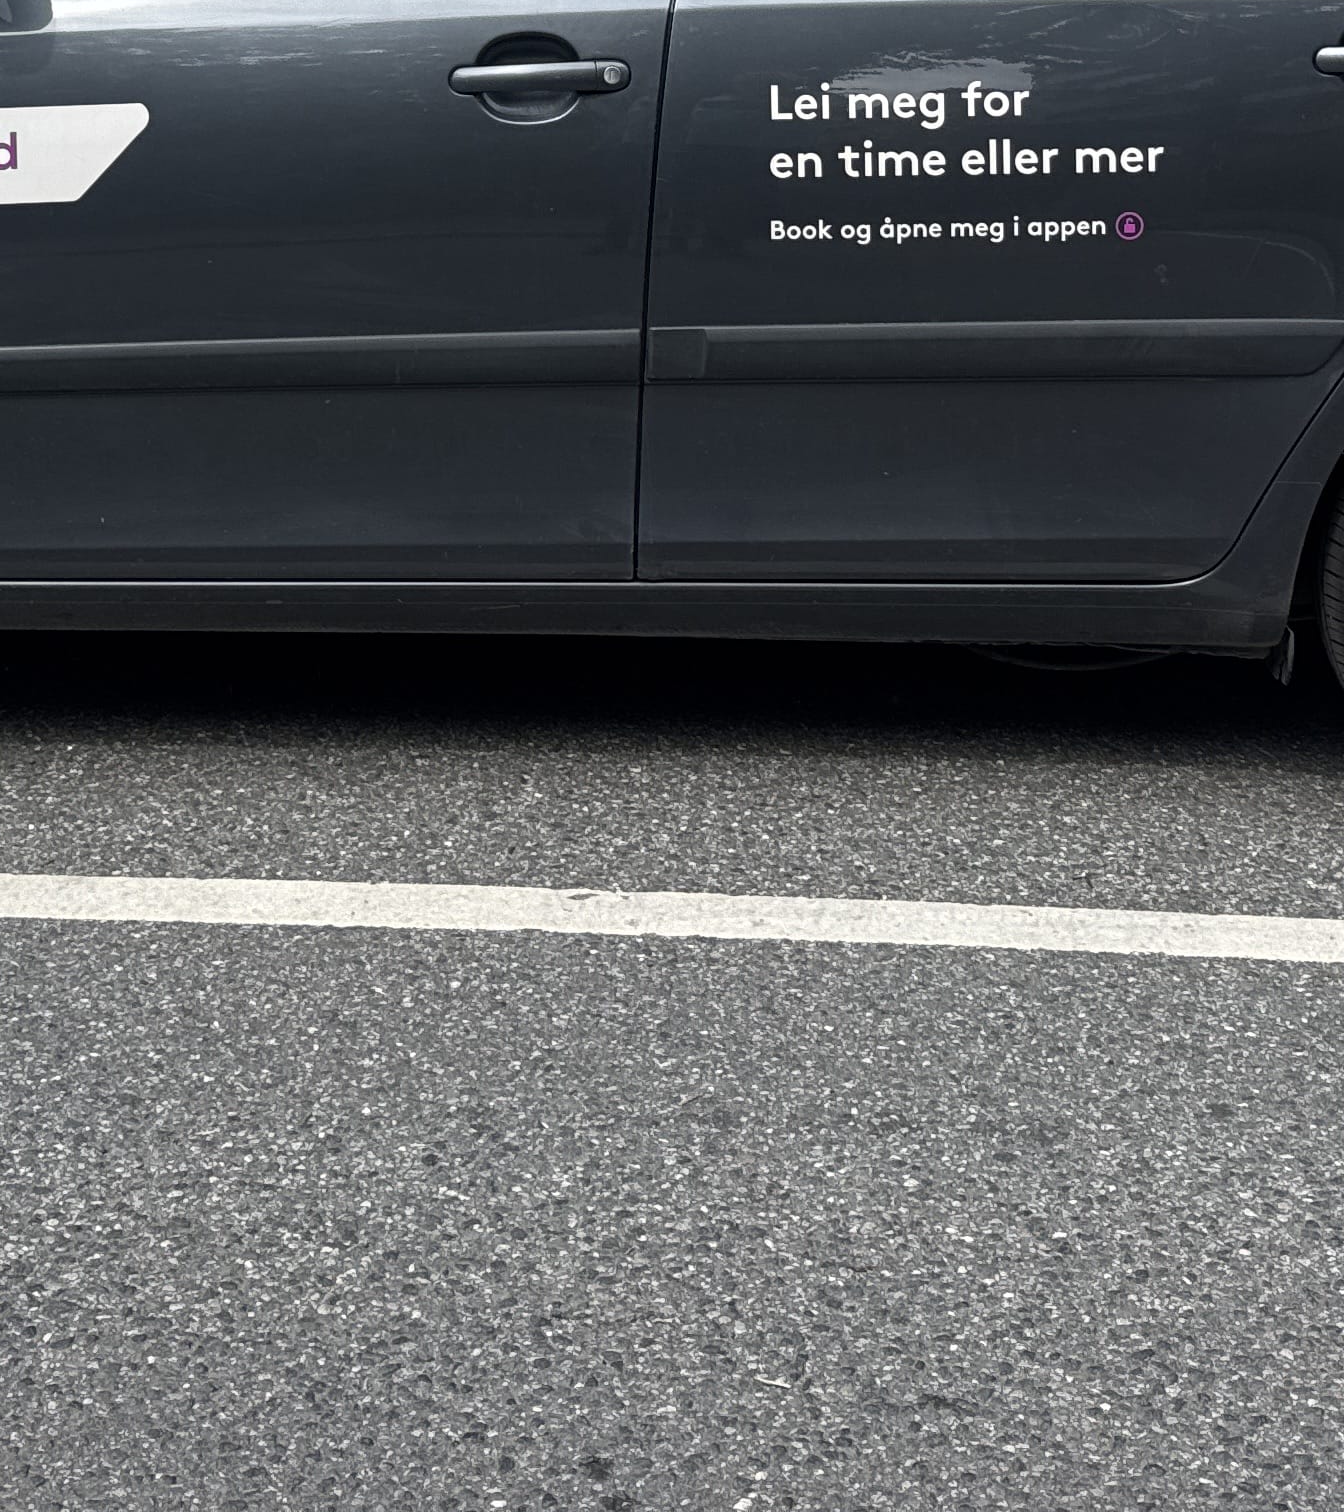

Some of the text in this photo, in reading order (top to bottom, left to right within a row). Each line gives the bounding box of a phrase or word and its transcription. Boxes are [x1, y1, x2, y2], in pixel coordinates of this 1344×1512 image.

[770, 80, 1030, 130] Lei meg for
[769, 138, 1165, 179] en time eller mer
[770, 215, 1106, 245] Book og åpne meg i appen
